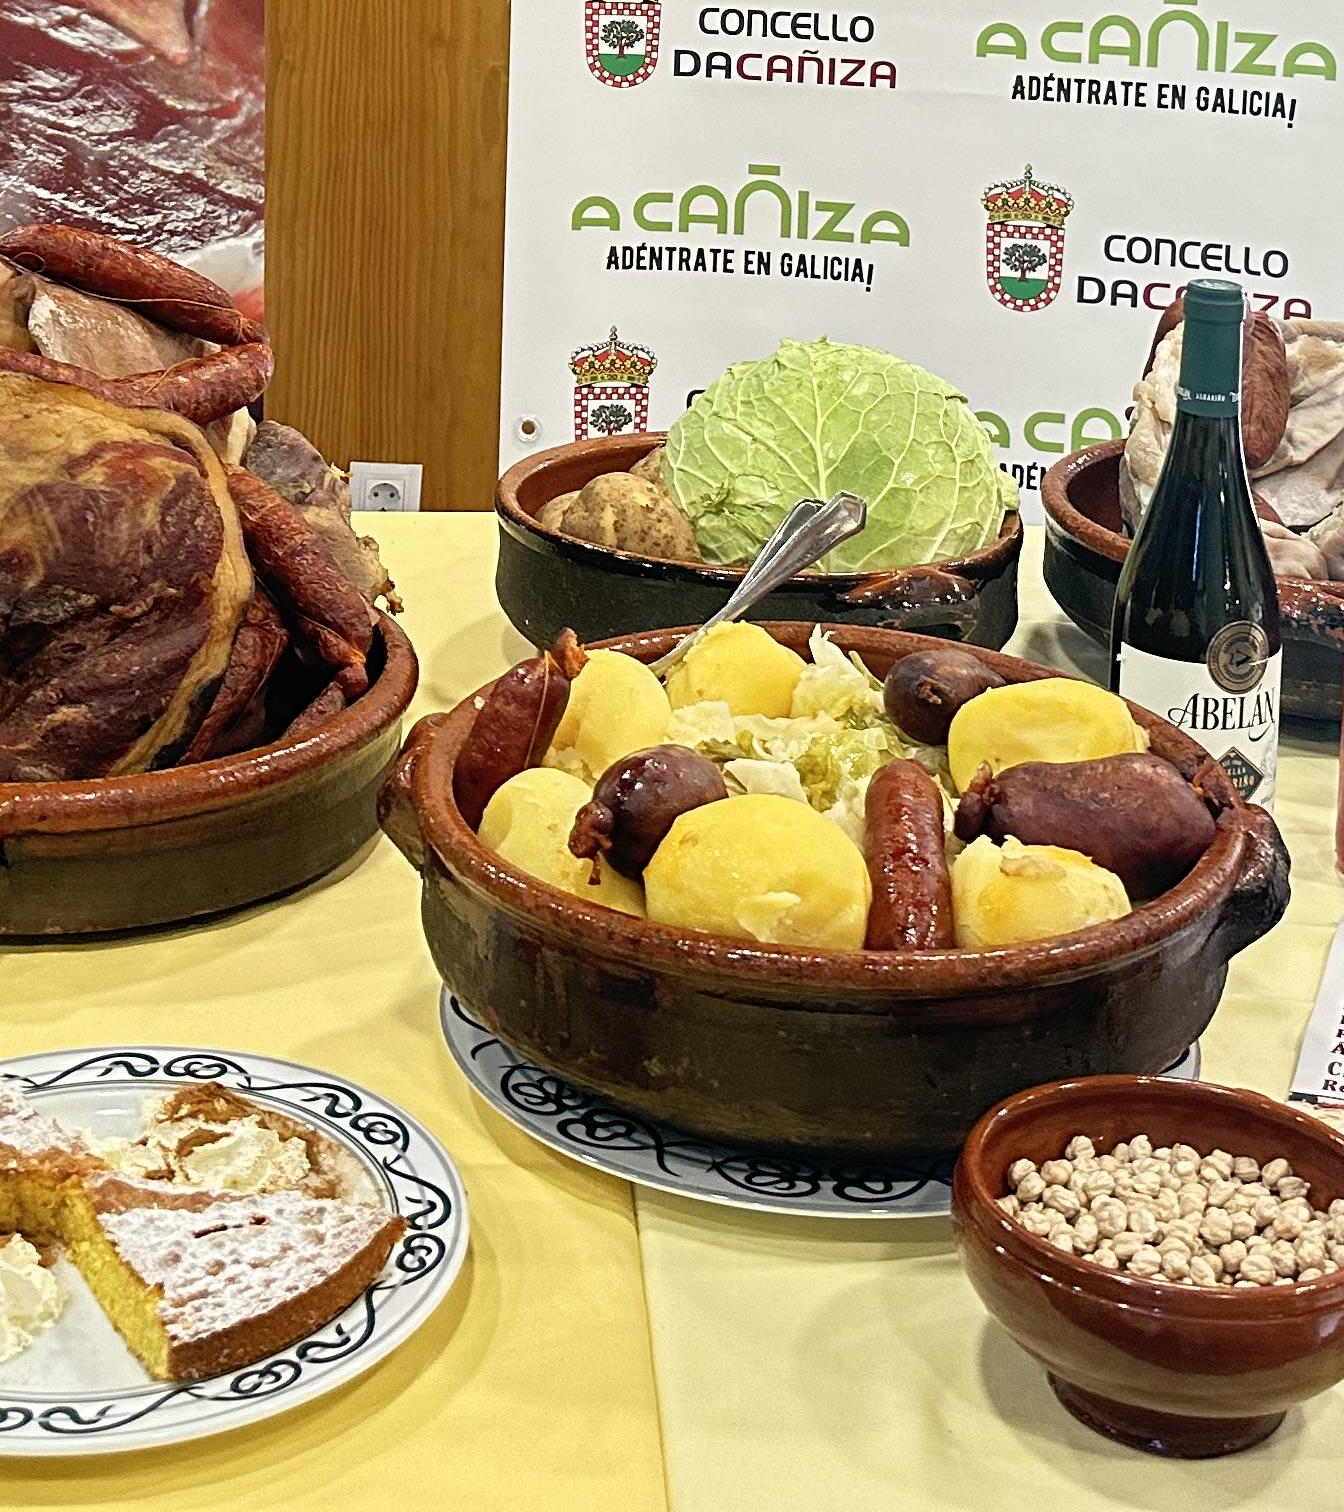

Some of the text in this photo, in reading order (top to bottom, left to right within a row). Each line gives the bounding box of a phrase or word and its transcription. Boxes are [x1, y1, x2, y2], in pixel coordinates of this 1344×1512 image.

[698, 6, 876, 43] CONCELLO
[976, 20, 1029, 60] A
[1011, 75, 1150, 110] ADÉNTRATE
[1157, 81, 1188, 111] EN
[570, 164, 912, 248] A CAÑIZA
[605, 244, 737, 276] ADÉNTRATE
[743, 249, 773, 277] EN
[1103, 233, 1290, 279] CONCELLO
[1076, 276, 1313, 321] DACZA
[1167, 683, 1275, 741] ABELÁN
